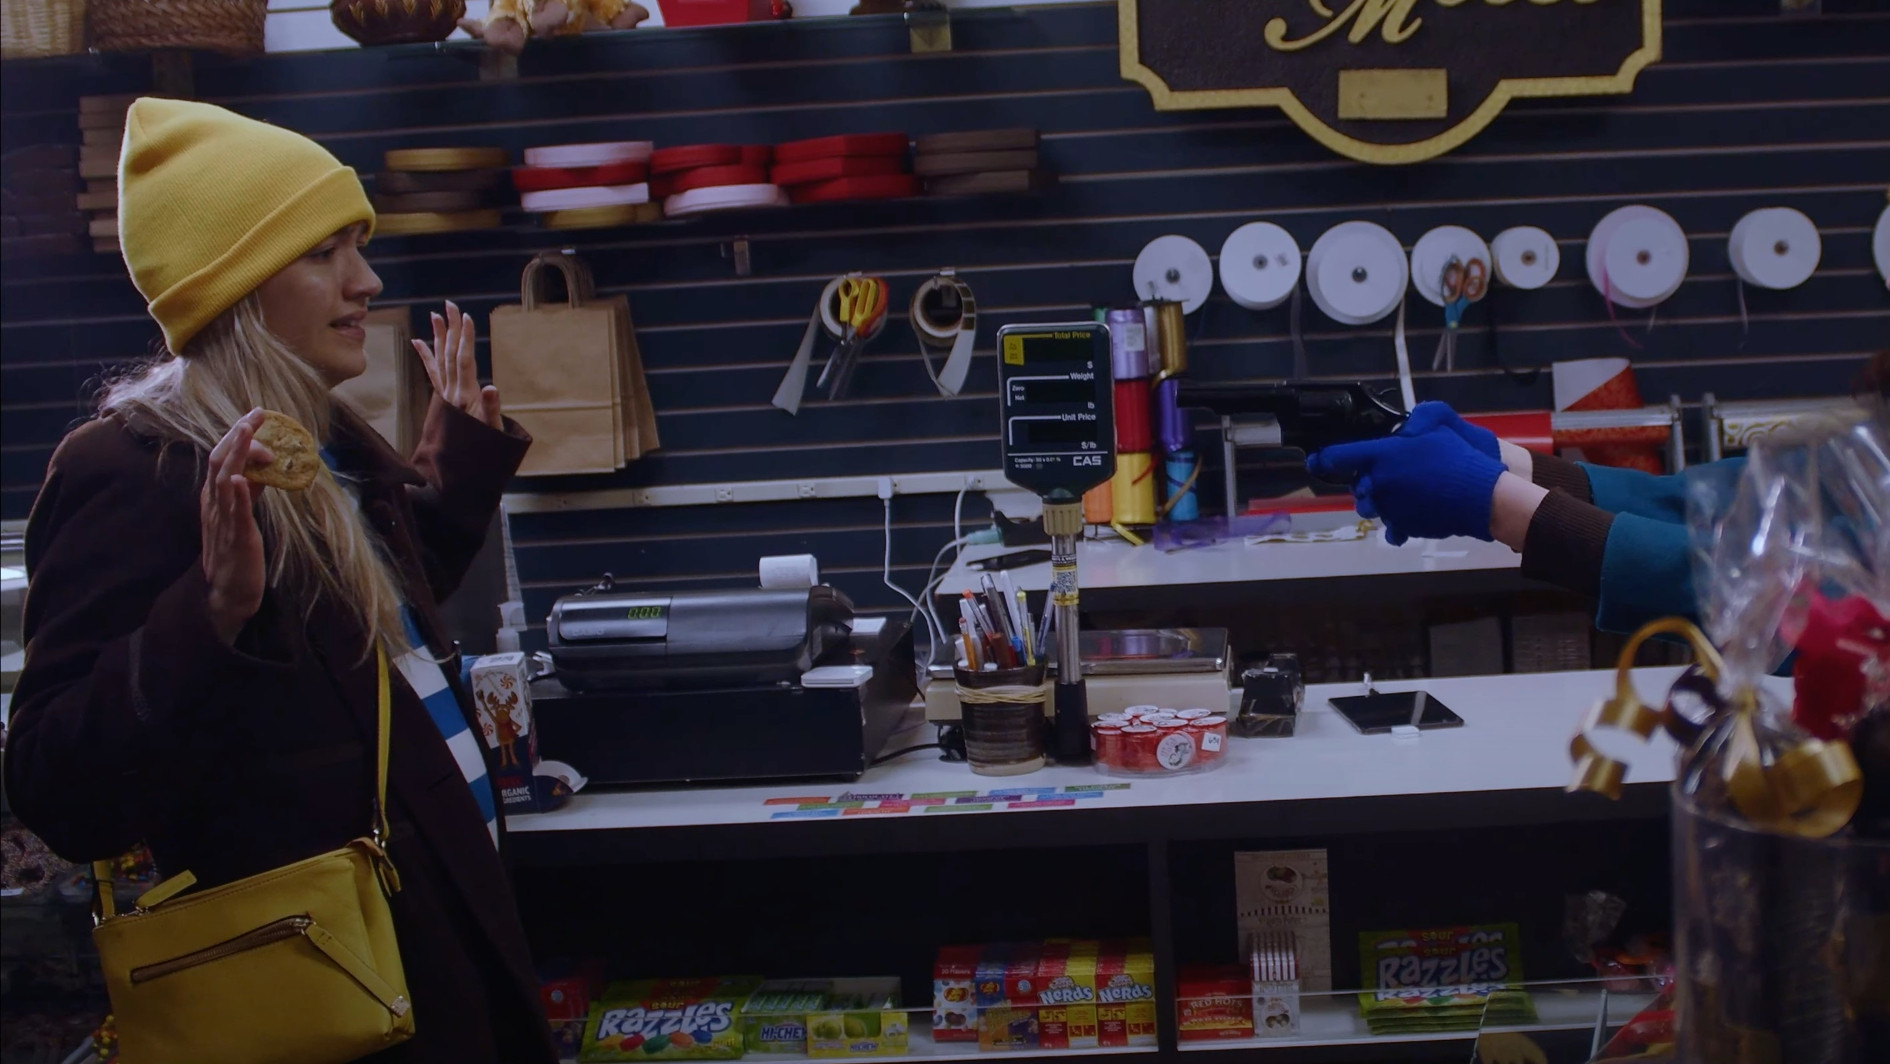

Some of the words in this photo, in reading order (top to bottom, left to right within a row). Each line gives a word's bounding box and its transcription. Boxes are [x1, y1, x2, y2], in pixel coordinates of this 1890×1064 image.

[1070, 372, 1094, 381] Weight
[1062, 413, 1076, 421] Unit
[1078, 412, 1096, 420] Price
[1073, 455, 1102, 466] CAS
[501, 786, 530, 797] RGANIC
[1422, 930, 1456, 942] sour
[1190, 998, 1212, 1008] RED
